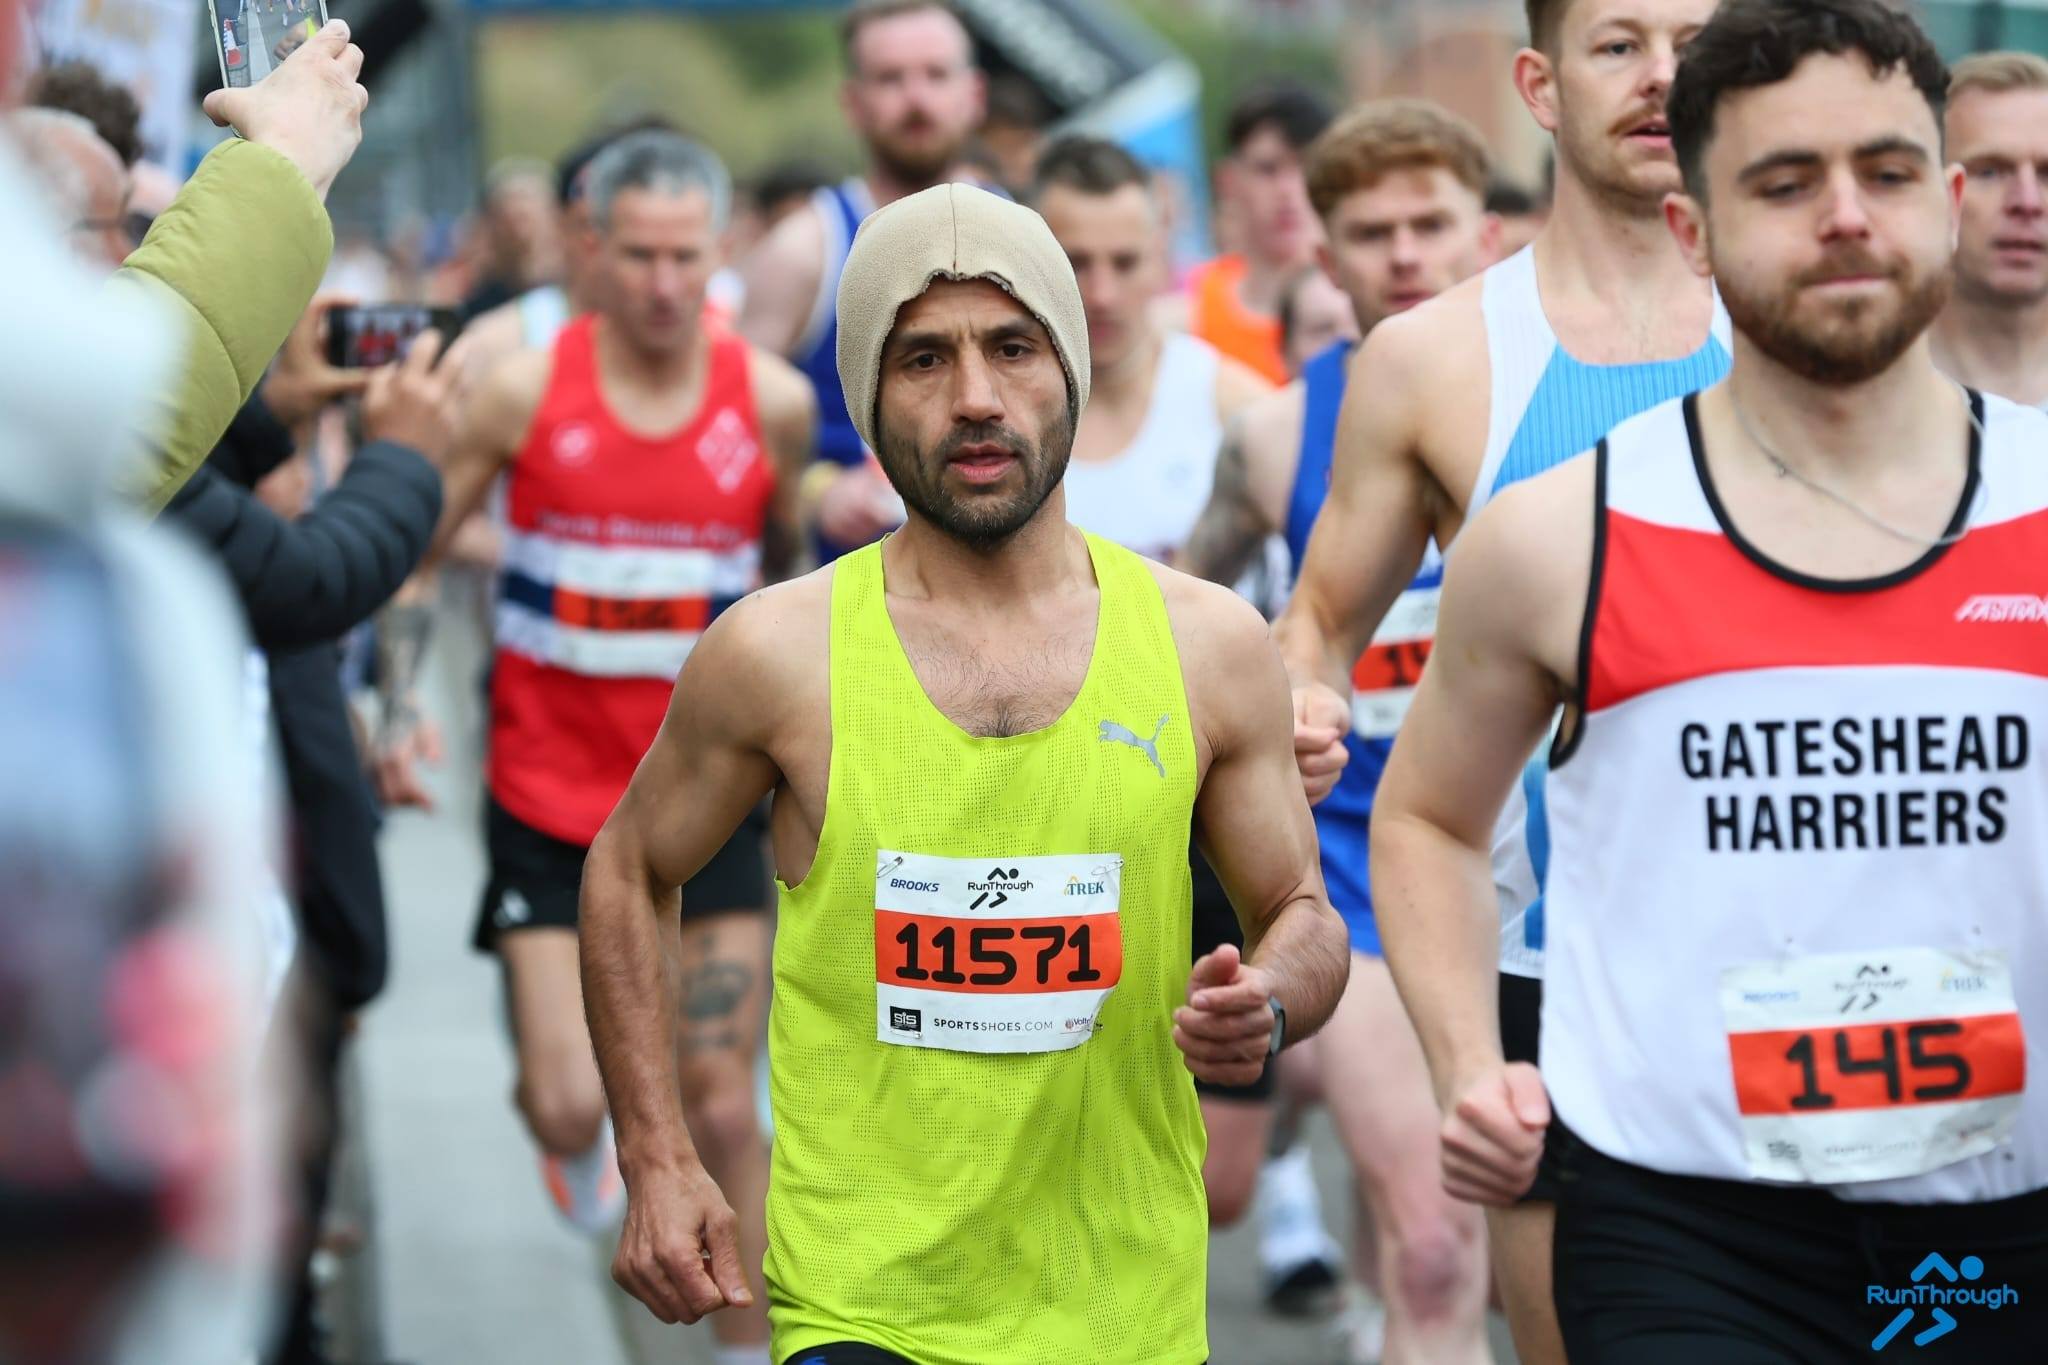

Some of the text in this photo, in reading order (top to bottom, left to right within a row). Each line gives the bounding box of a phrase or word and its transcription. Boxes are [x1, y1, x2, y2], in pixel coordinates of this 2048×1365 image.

[1680, 714, 2030, 780] GATESHEAD
[1705, 786, 2008, 852] HARRIERS
[890, 878, 940, 892] BROOKS
[967, 880, 1034, 892] RunThrough
[1066, 881, 1105, 896] TREK
[895, 922, 1101, 986] 11571
[933, 1018, 1054, 1032] SPORTSSHOES.COM
[1785, 1020, 1973, 1110] 145
